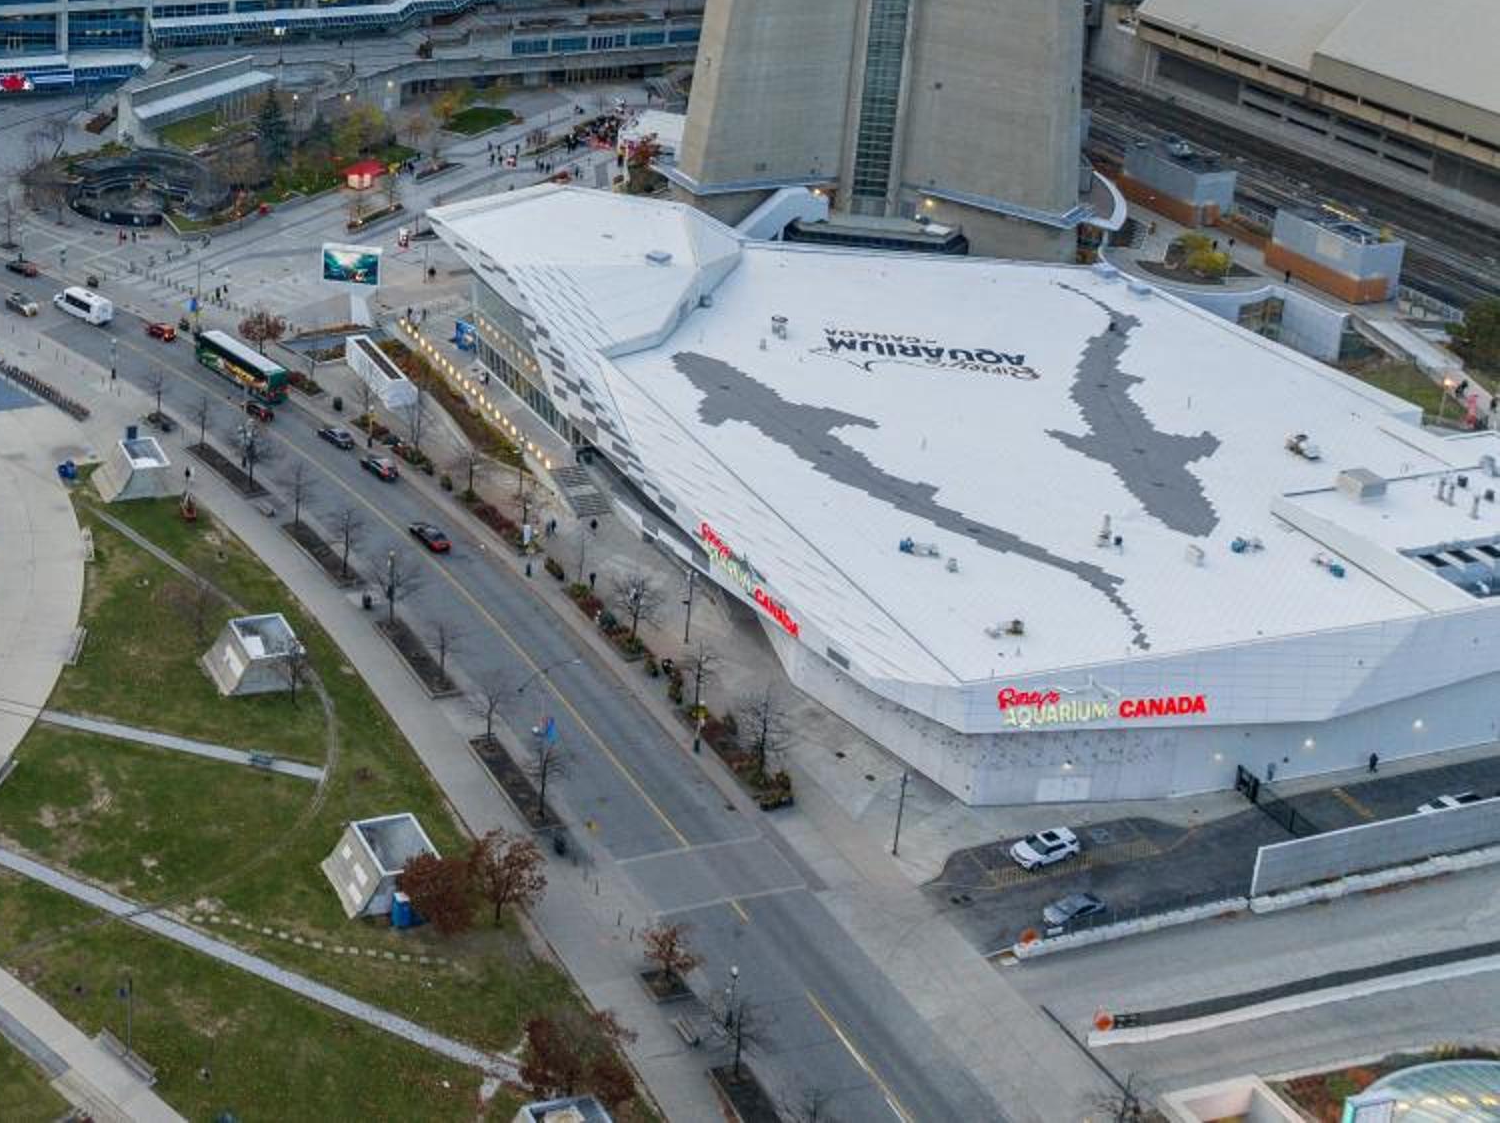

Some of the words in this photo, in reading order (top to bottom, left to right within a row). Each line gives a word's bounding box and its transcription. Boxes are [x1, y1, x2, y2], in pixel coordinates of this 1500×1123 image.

[824, 328, 921, 344] CANADA
[826, 337, 1026, 366] AQUARIUM
[1004, 700, 1108, 728] AQUARIUM
[1118, 695, 1207, 718] CANADA
